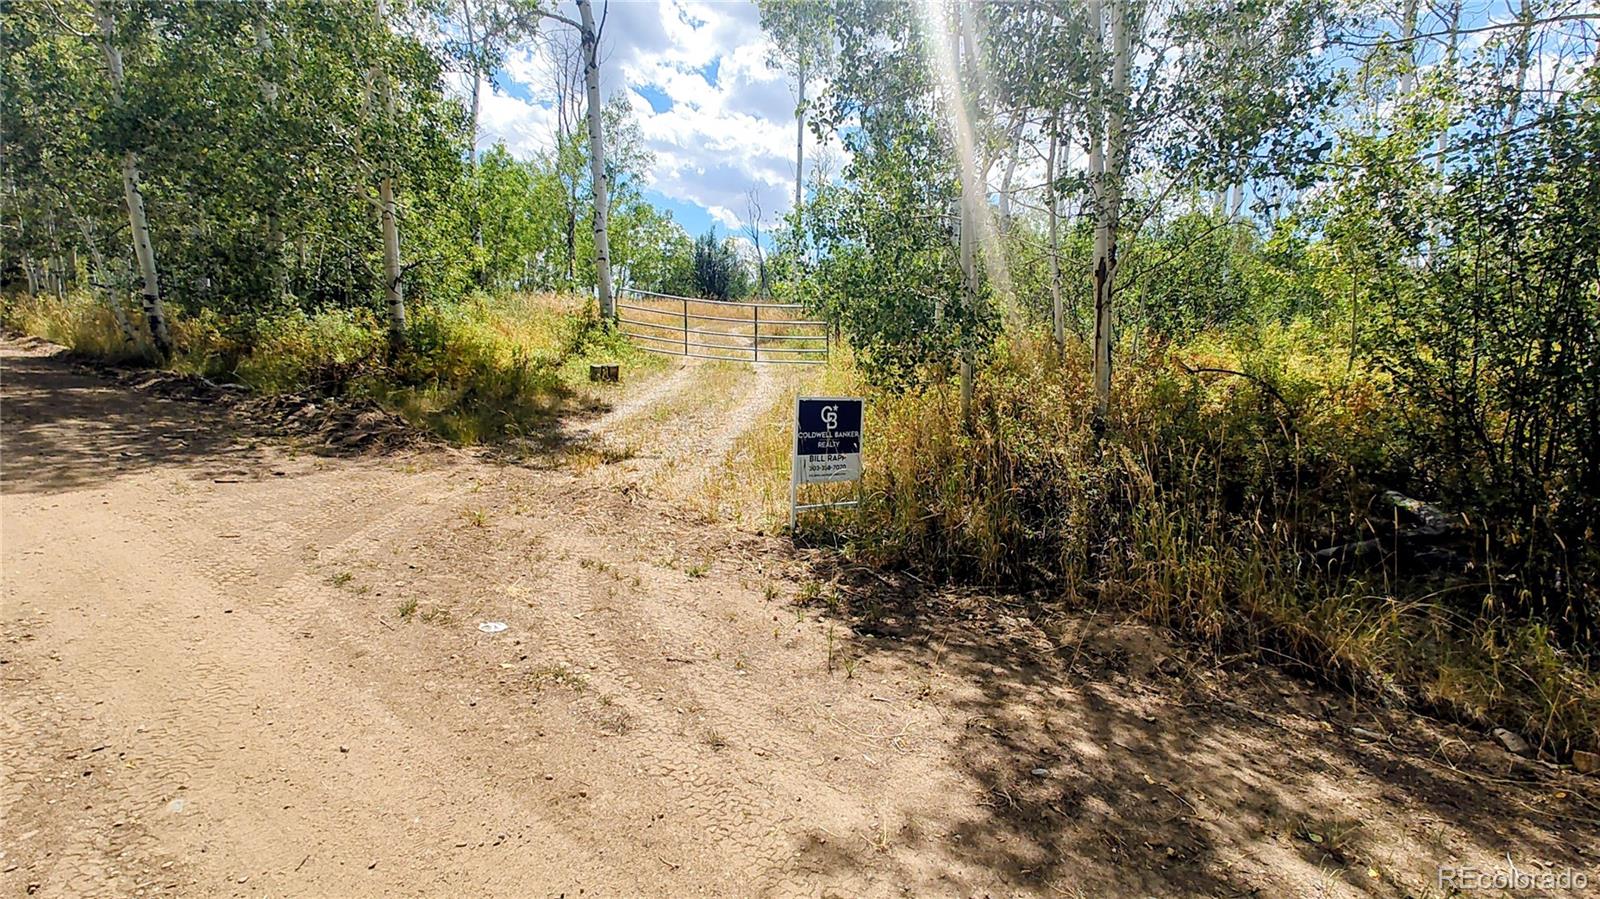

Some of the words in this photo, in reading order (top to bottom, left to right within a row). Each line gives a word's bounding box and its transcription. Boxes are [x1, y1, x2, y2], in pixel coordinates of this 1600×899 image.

[798, 431, 833, 439] COLDWELL
[834, 430, 860, 438] BANKER
[809, 454, 826, 463] BILL
